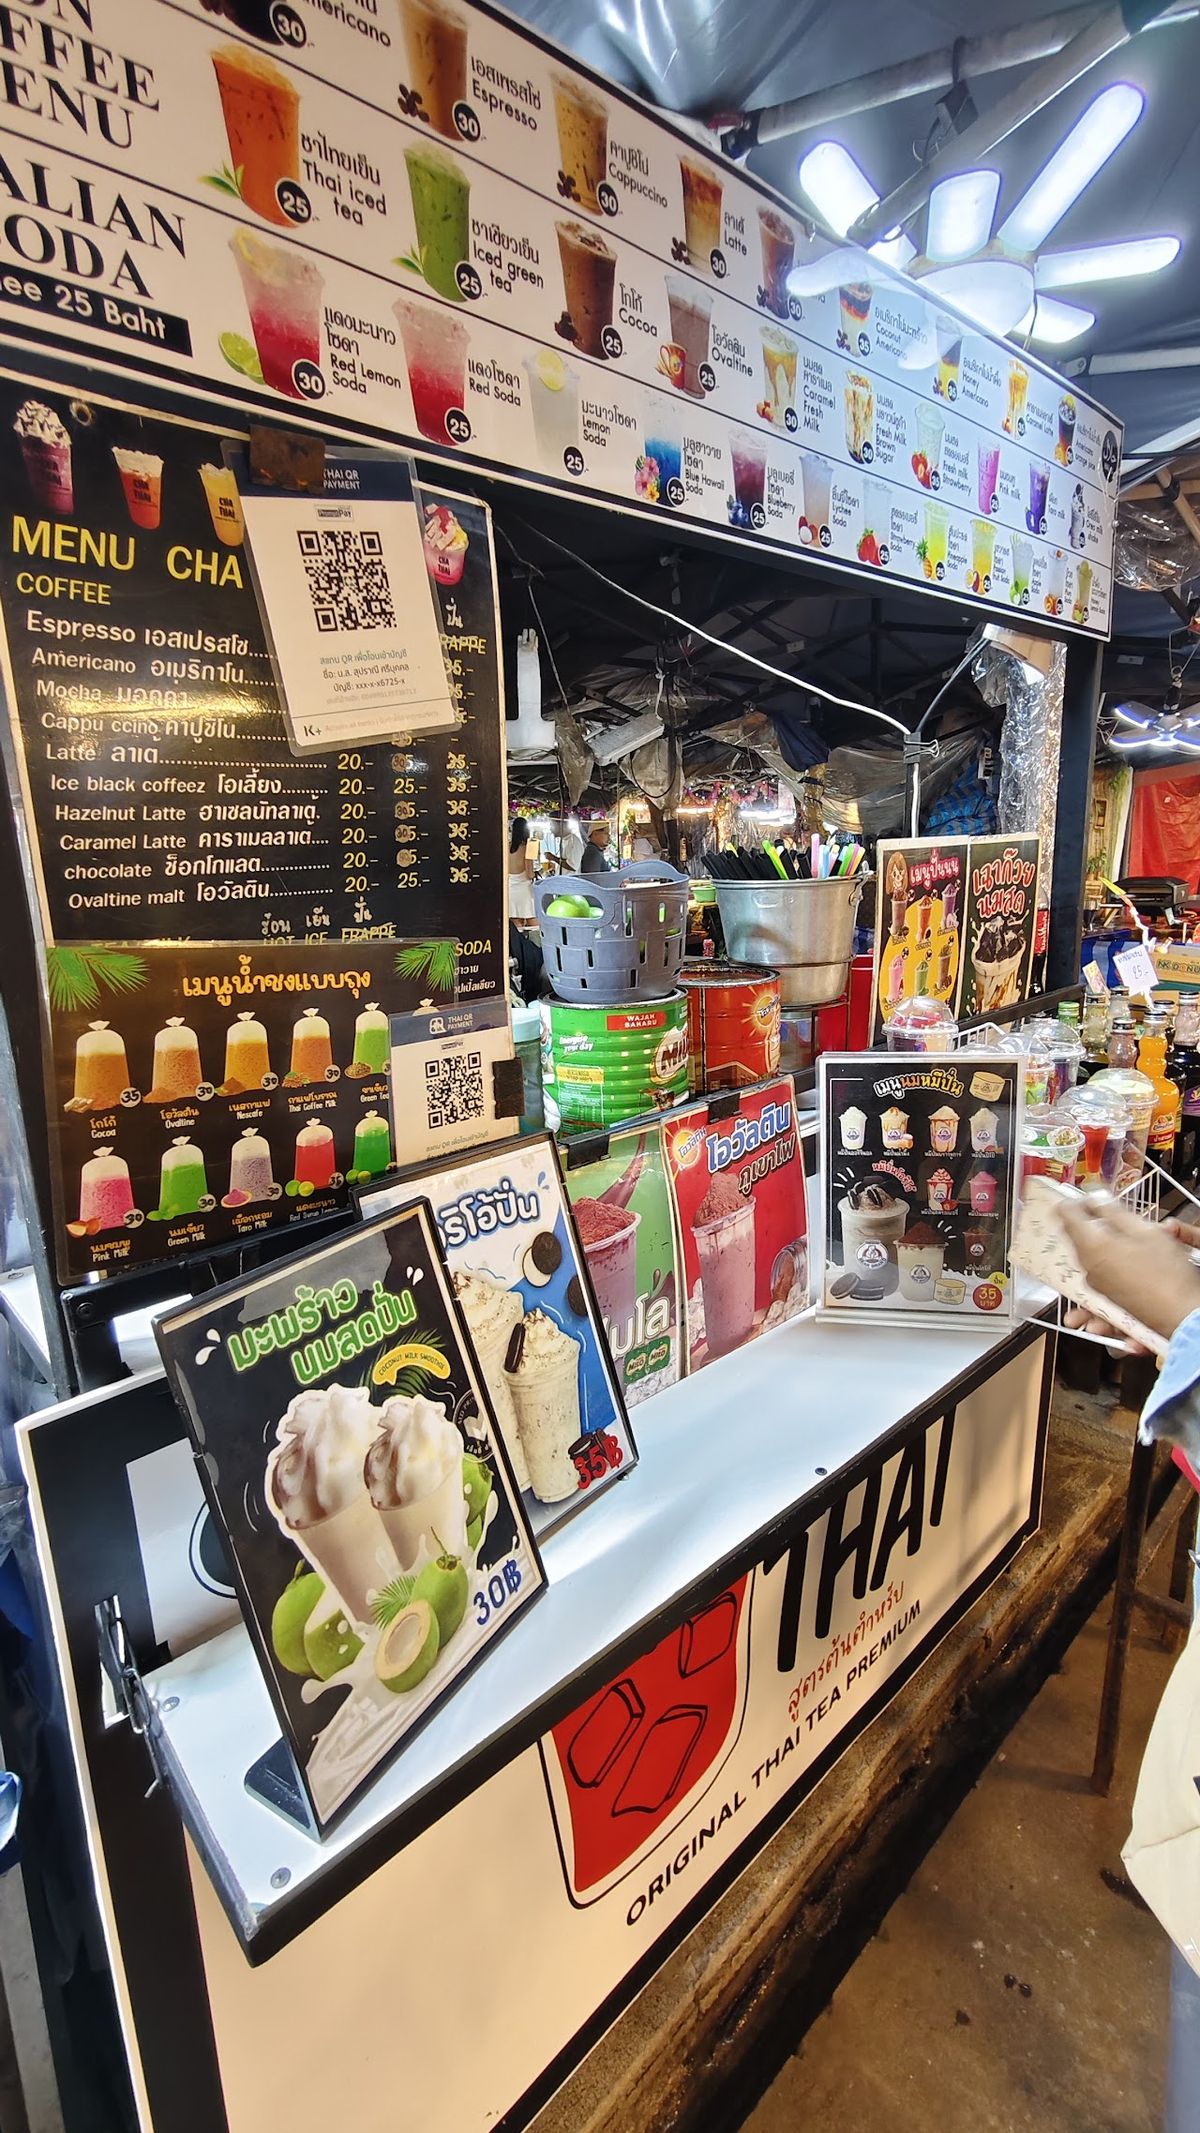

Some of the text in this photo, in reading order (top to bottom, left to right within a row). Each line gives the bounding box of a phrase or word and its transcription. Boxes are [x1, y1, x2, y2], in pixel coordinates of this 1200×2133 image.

[276, 14, 304, 38] 30
[472, 78, 537, 131] Espresso
[456, 112, 478, 136] 30
[301, 158, 388, 216] Thai iced
[608, 162, 668, 208] Cappuccino
[281, 191, 308, 216] 25
[600, 190, 618, 212] 30
[333, 197, 364, 226] tea
[724, 232, 748, 256] Latte
[473, 240, 544, 289] Iced green
[711, 257, 726, 275] 30
[459, 272, 481, 296] 25
[489, 268, 512, 294] tea
[54, 284, 167, 341] 25 Baht
[618, 306, 658, 338] Cocoa
[605, 334, 622, 350] 25
[330, 353, 401, 389] Red Lemon
[711, 346, 753, 377] Ovaltine
[297, 373, 326, 395] 30
[331, 371, 368, 395] Soda
[700, 372, 716, 388] 25
[469, 379, 521, 407] Red Soda
[803, 385, 836, 410] Caramel
[803, 401, 824, 419] Fresh
[582, 416, 611, 435] Lemon
[785, 413, 797, 427] 30
[803, 416, 821, 433] Milk
[449, 421, 469, 439] 25
[583, 428, 607, 448] Soda
[875, 424, 906, 447] Fresh Milk
[566, 455, 583, 470] 25
[875, 448, 894, 464] Sugar
[323, 480, 361, 491] PAYMENT
[684, 469, 725, 491] Blue Hawaii
[685, 480, 704, 497] Soda
[669, 486, 684, 502] 25
[767, 494, 796, 515] Blueberry
[767, 505, 784, 520] Soda
[832, 500, 852, 518] Lychee
[753, 509, 766, 524] 25
[832, 514, 847, 528] Soda
[819, 529, 832, 542] 25
[12, 514, 244, 590] MENU CHA
[890, 541, 902, 554] Soda
[16, 571, 112, 606] COFFEE
[26, 608, 137, 644] Espresso
[31, 646, 137, 674] Americano
[36, 679, 101, 702] Mocha
[41, 711, 104, 734] Cappu
[46, 743, 97, 762] Latte
[337, 753, 374, 771] 20.-
[51, 774, 80, 791] Ice
[87, 776, 136, 792] black
[142, 777, 206, 793] coffeez
[339, 777, 428, 796] 20.- 25.-
[55, 804, 187, 821] Hazelnut Latte
[340, 803, 377, 821] 20.-
[60, 834, 187, 851] Caramel Latte
[341, 828, 378, 846] 20.-
[343, 852, 379, 870] 20.-
[64, 863, 153, 880] chocolate
[344, 872, 430, 893] 20.- 25.-
[68, 890, 142, 909] Ovaltine
[148, 888, 185, 906] malt
[455, 939, 492, 958] SODA
[262, 1077, 279, 1088] 30
[326, 1068, 339, 1079] 30
[120, 1090, 140, 1103] 35
[197, 1086, 213, 1098] 30
[360, 1093, 377, 1103] Green
[236, 1109, 264, 1121] Nescafe
[288, 1099, 337, 1113] Thai Coffee Milk
[165, 1117, 195, 1129] Ovaltine
[91, 1128, 116, 1139] Cocoa
[706, 1101, 791, 1174] โอวัลติน
[738, 1131, 796, 1197] ภูเขาไฟ
[199, 1198, 214, 1209] 30
[125, 1211, 143, 1224] 30
[236, 1219, 268, 1234] Taro Milk
[168, 1231, 206, 1248] Green Milk
[92, 1248, 130, 1263] Pink Milk
[978, 1287, 997, 1300] 35
[227, 1278, 359, 1373] มะพร้าว
[292, 1280, 418, 1386] นมสดปั่น
[379, 1354, 403, 1376] COCONUT
[763, 1414, 958, 1674] THAI
[625, 1599, 923, 1927] ORIGINAL THAI TEA PREMIUM
